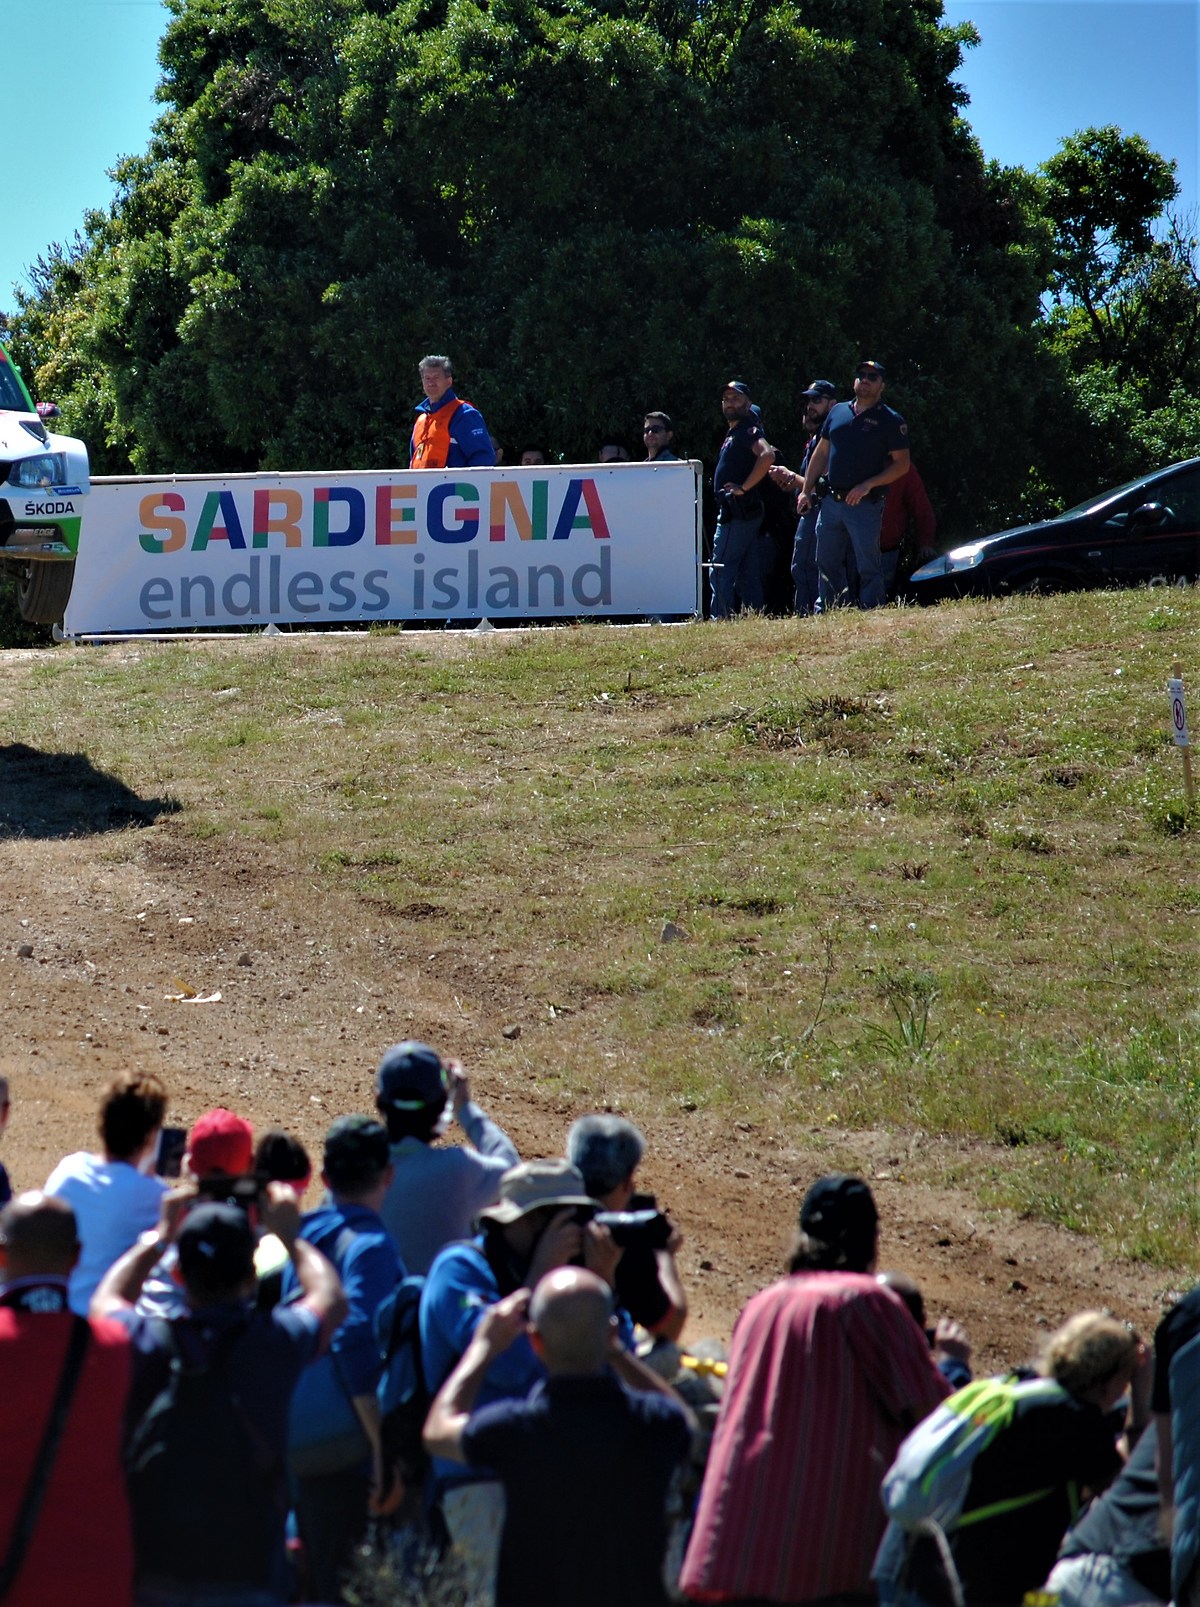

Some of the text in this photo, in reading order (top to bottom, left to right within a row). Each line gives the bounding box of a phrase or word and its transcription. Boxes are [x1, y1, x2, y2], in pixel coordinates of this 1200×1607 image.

[25, 501, 75, 516] ŠKODA
[138, 478, 611, 554] SARDEGNA
[33, 528, 56, 536] EDGE
[40, 543, 64, 552] RS
[138, 545, 612, 620] endless island
